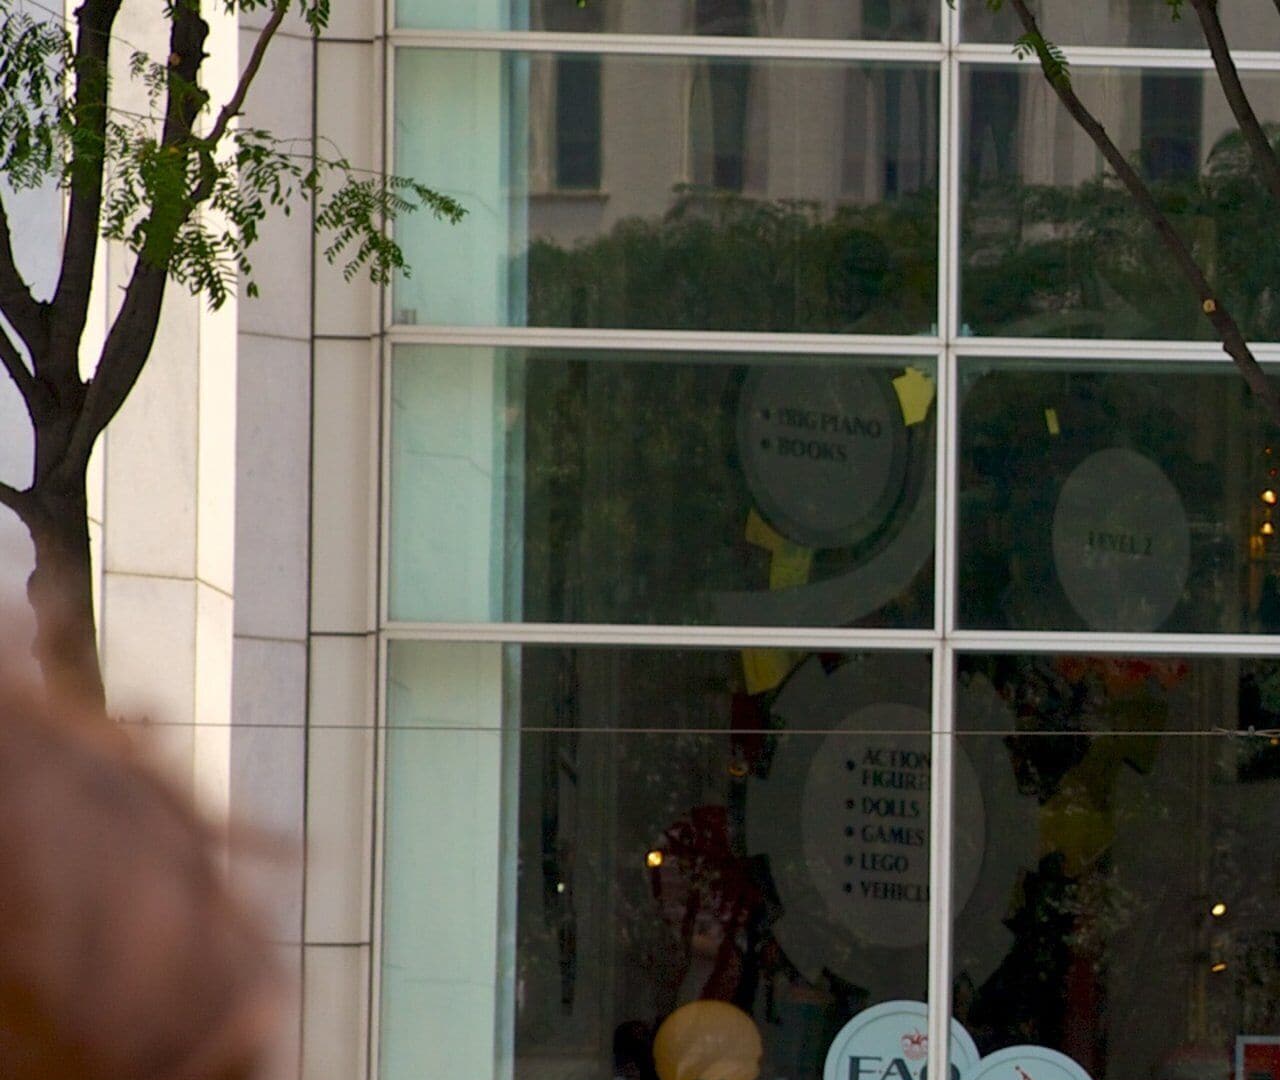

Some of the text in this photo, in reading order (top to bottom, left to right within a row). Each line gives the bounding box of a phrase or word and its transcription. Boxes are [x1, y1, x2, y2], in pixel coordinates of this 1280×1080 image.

[777, 436, 848, 463] BOOKS
[861, 770, 930, 790] FIGURE
[862, 797, 920, 818] DOLLS
[861, 825, 925, 846] GAMES
[860, 852, 909, 874] LEGO
[860, 879, 929, 902] VEHICL
